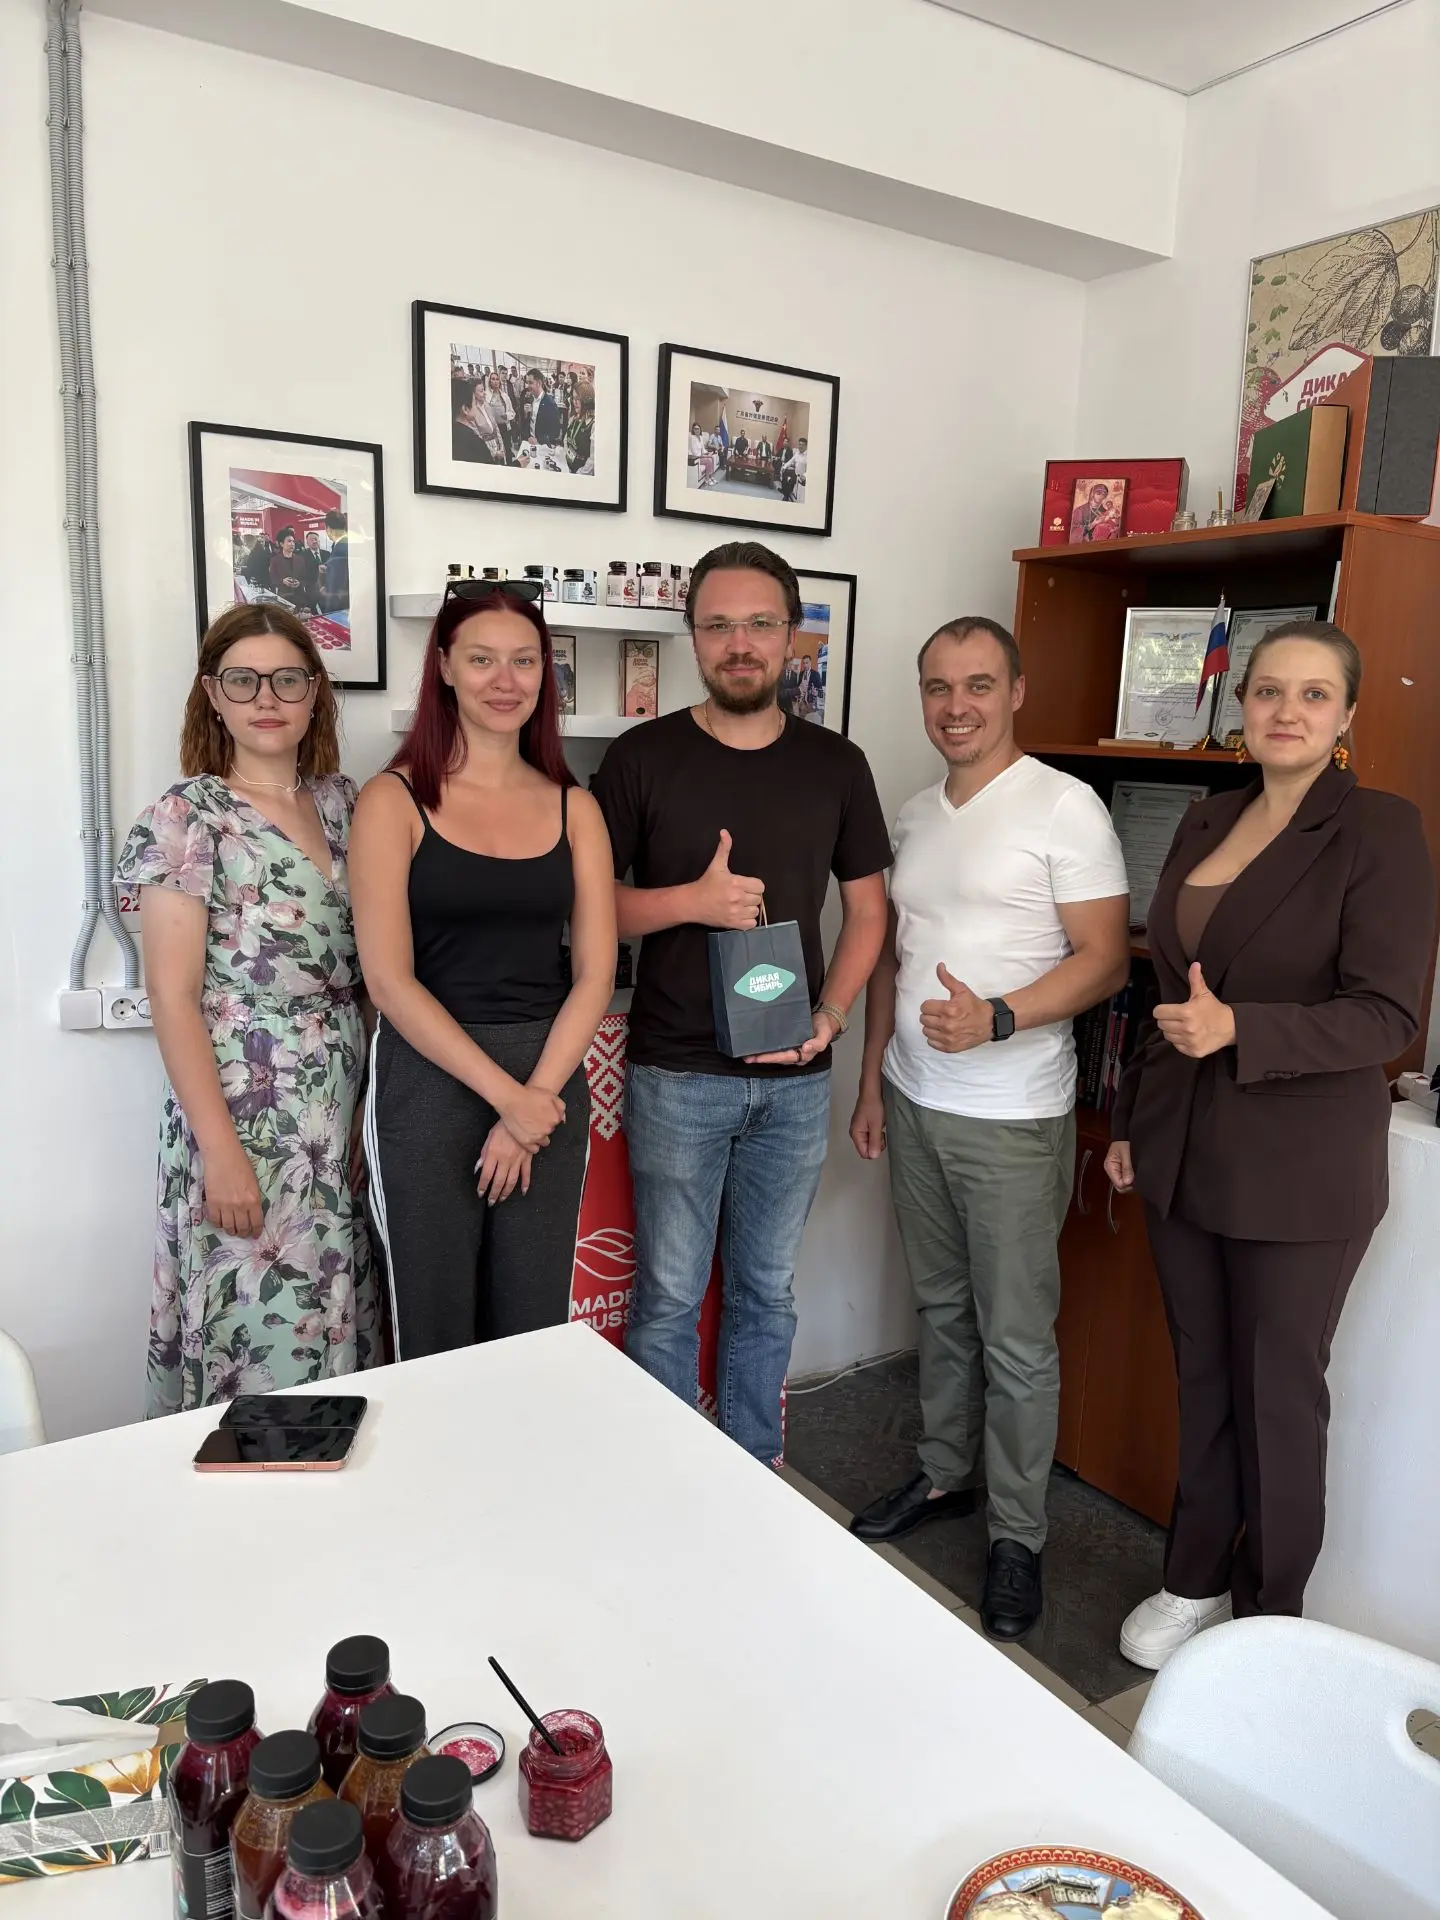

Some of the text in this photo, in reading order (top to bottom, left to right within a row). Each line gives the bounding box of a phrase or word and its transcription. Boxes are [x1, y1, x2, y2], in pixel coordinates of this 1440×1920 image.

[1301, 372, 1348, 398] ДИКА
[749, 972, 780, 986] ДИКАЯ
[749, 981, 783, 994] СИБИРЬ
